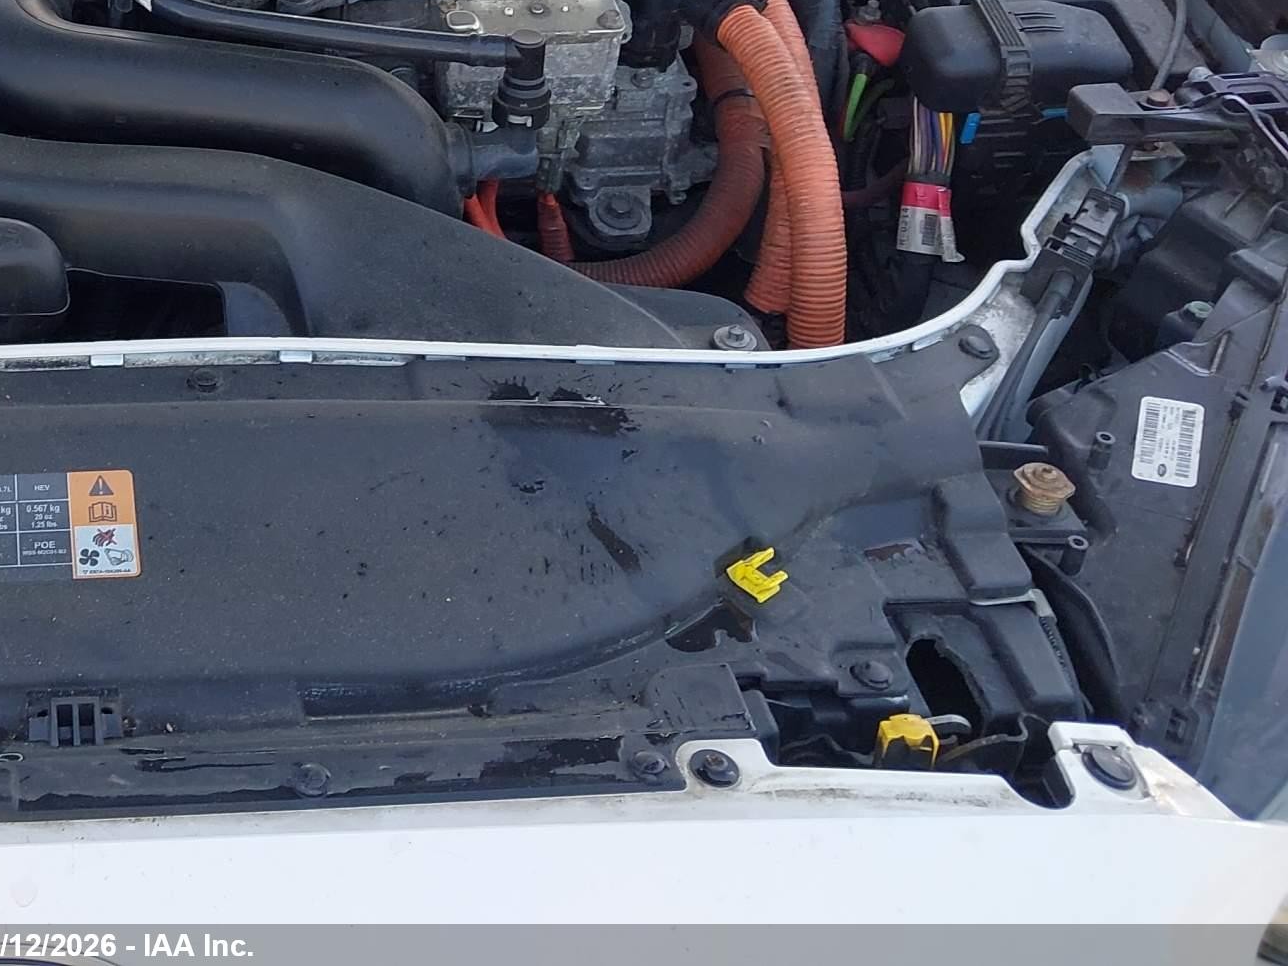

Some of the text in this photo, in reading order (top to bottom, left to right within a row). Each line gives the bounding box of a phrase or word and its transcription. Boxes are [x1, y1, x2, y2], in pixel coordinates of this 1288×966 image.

[0, 506, 11, 515] kg
[50, 504, 60, 513] kg
[34, 541, 56, 549] POE
